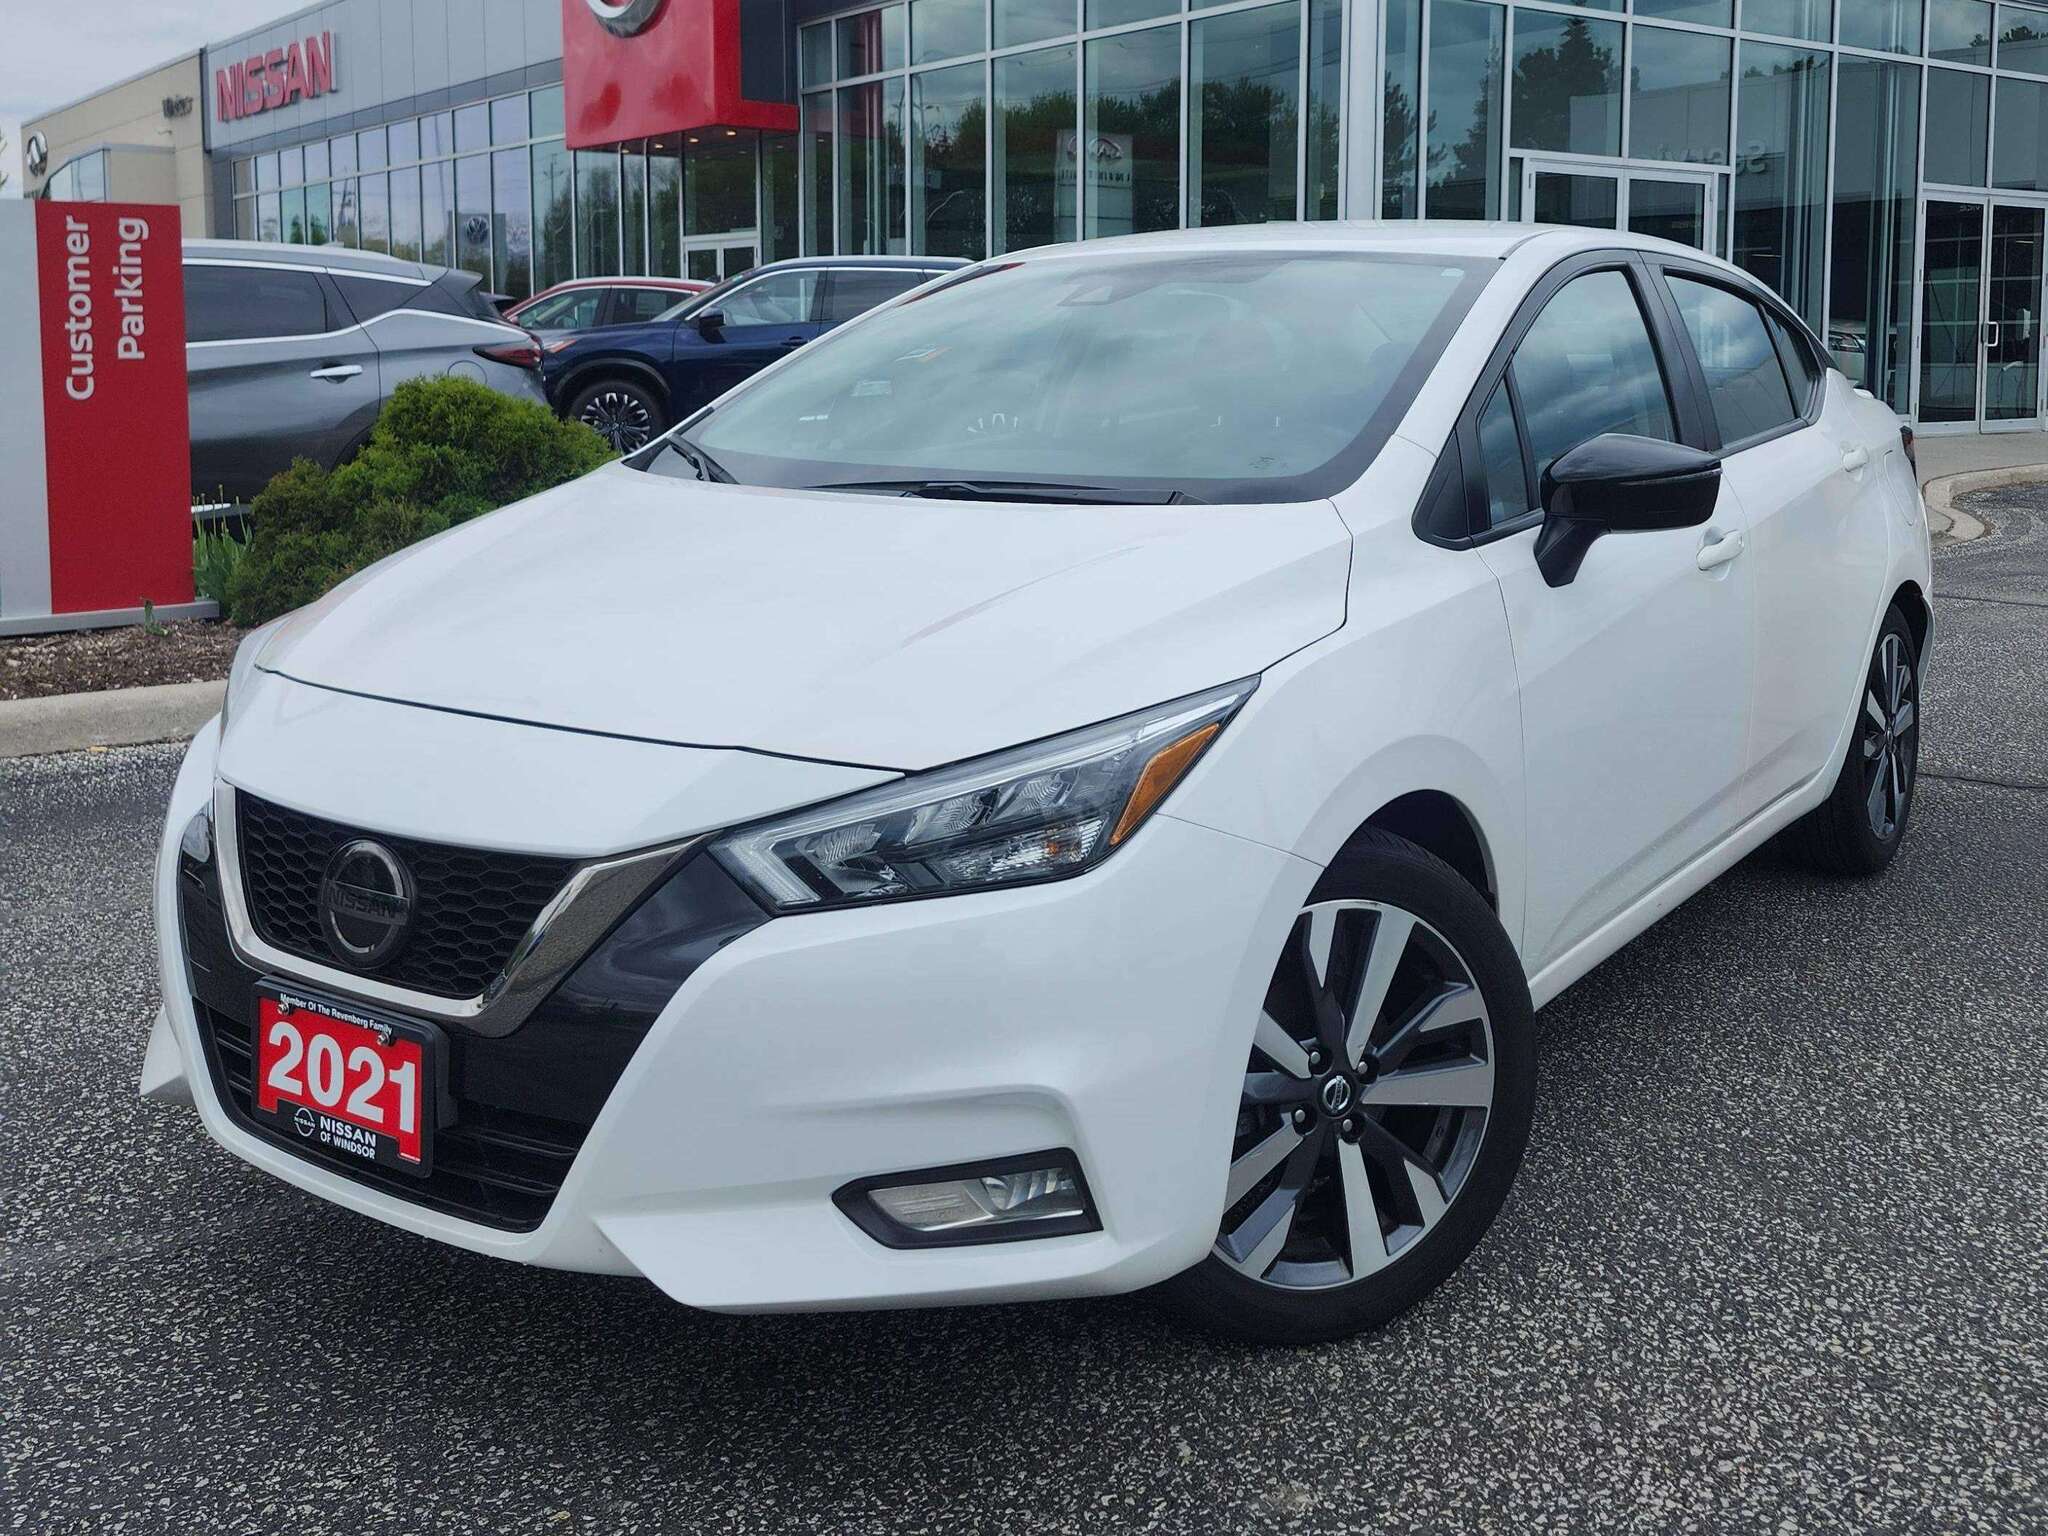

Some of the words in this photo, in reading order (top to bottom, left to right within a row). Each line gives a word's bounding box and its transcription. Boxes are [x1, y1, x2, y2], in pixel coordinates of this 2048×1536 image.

[216, 32, 332, 122] NISSAN
[65, 215, 95, 400] Customer
[112, 217, 150, 359] Parking
[328, 885, 399, 922] NISSAN
[280, 993, 306, 1008] Member
[318, 1004, 331, 1016] The
[369, 1020, 392, 1035] Family
[268, 1021, 416, 1134] 2021
[320, 1116, 376, 1147] NISSAN
[320, 1132, 332, 1143] OF
[333, 1136, 376, 1159] WINDSOR
